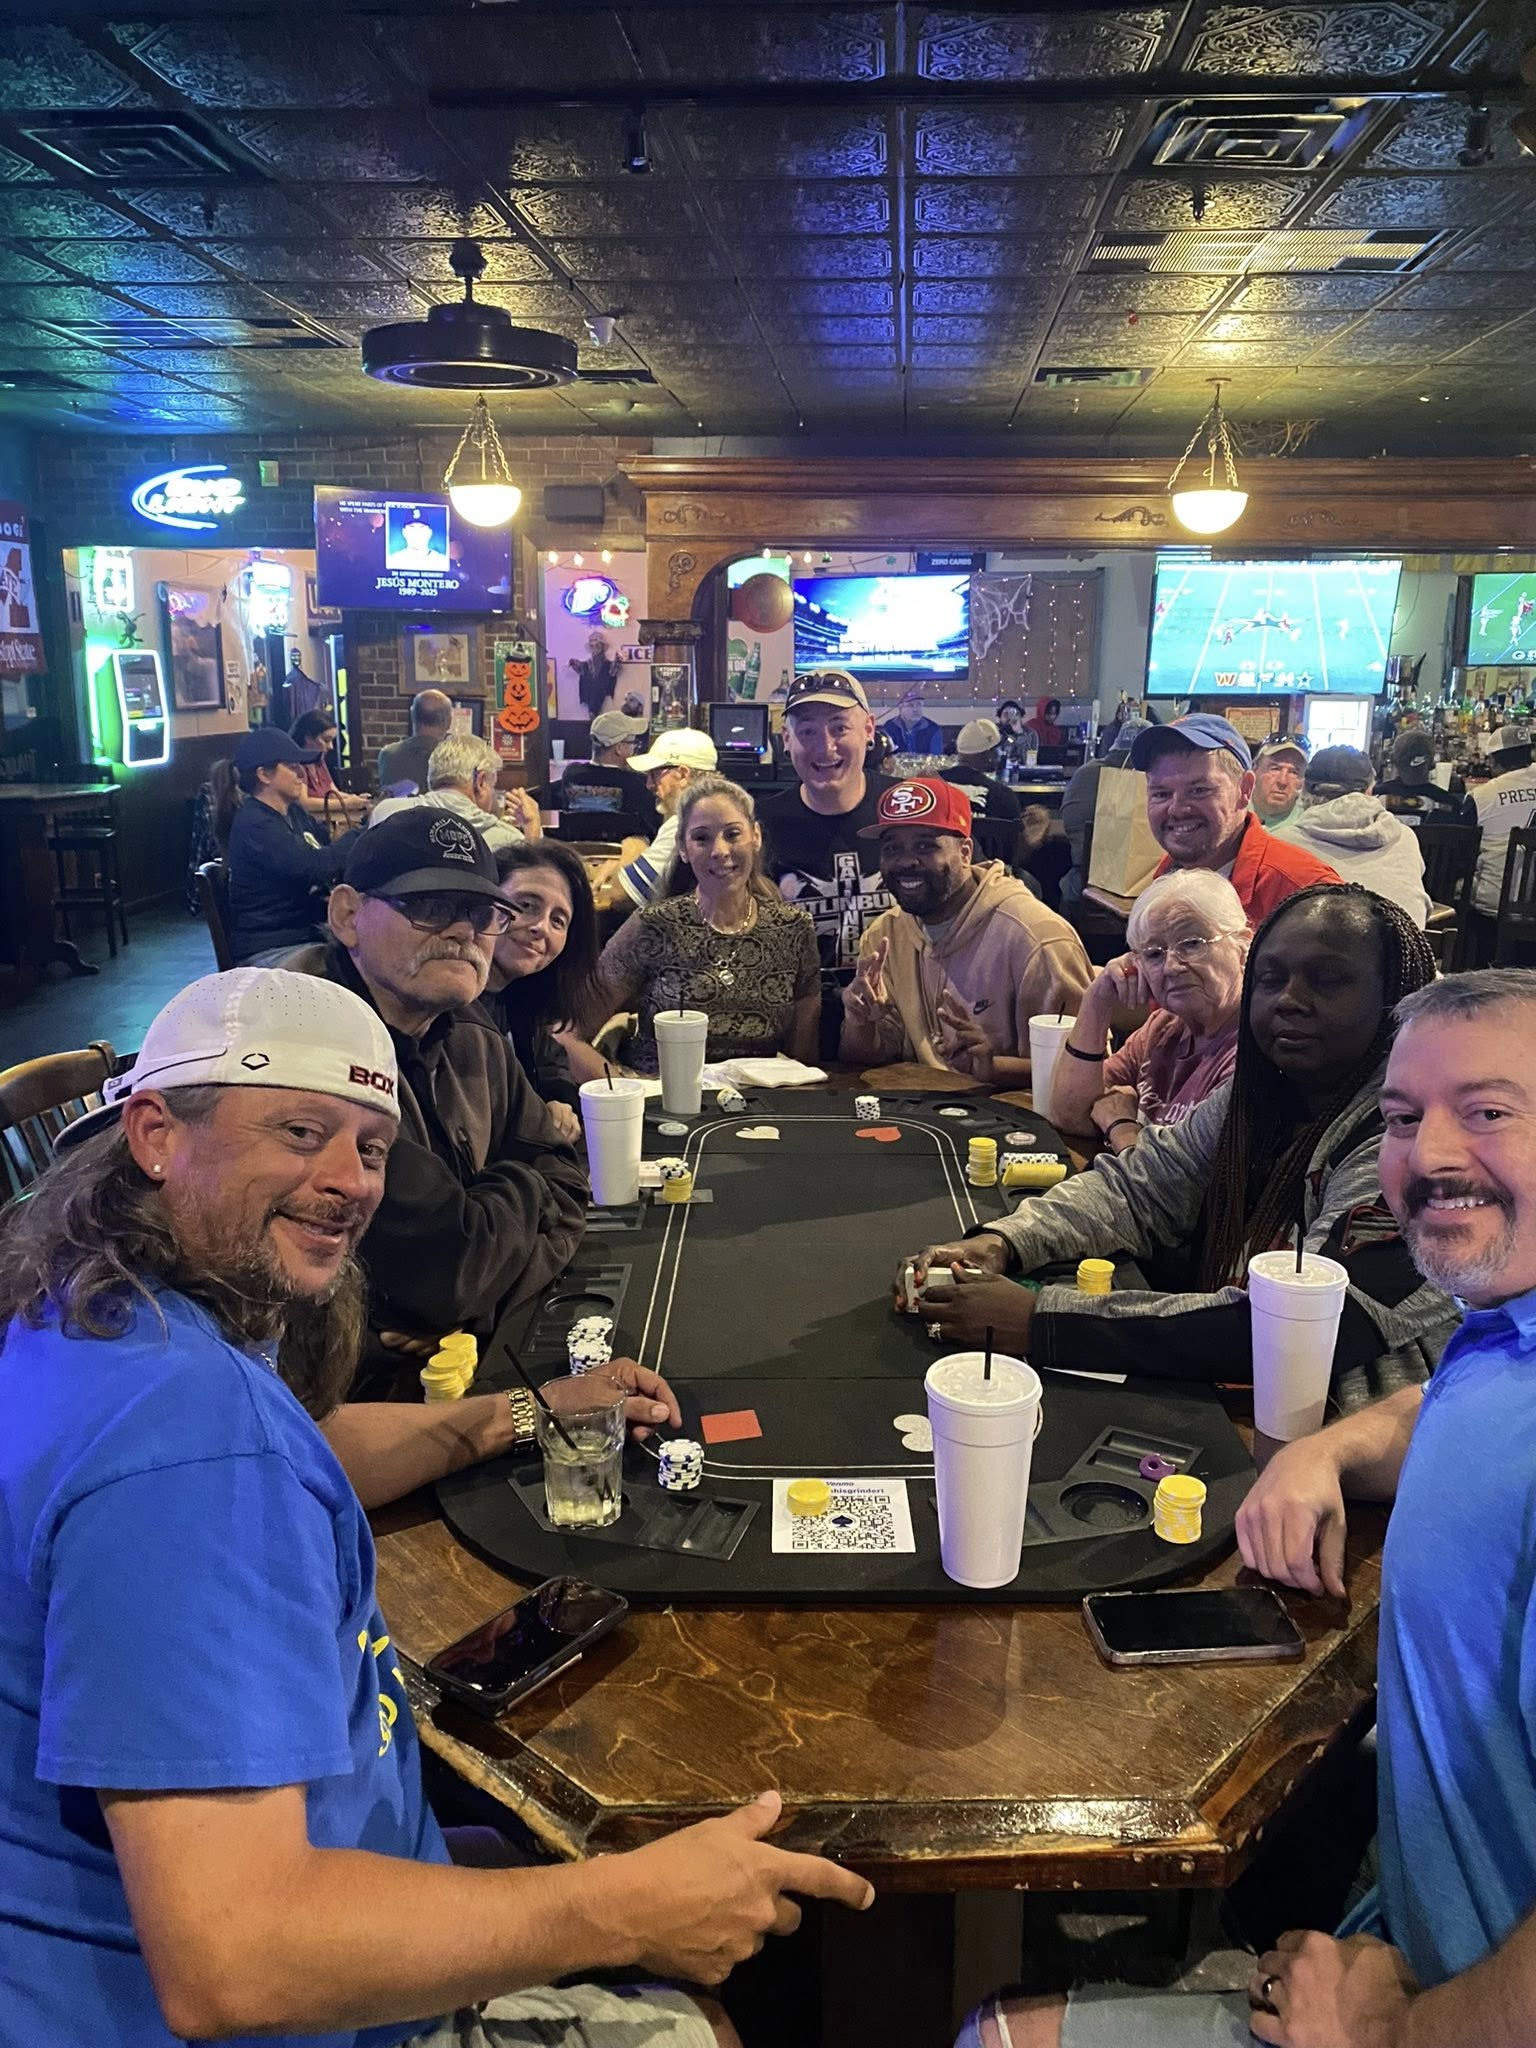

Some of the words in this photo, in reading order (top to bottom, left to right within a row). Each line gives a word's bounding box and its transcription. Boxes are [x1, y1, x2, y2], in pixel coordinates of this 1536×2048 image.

[407, 578, 460, 590] MONTERO
[1497, 787, 1536, 806] PRES
[349, 1064, 395, 1098] BOX
